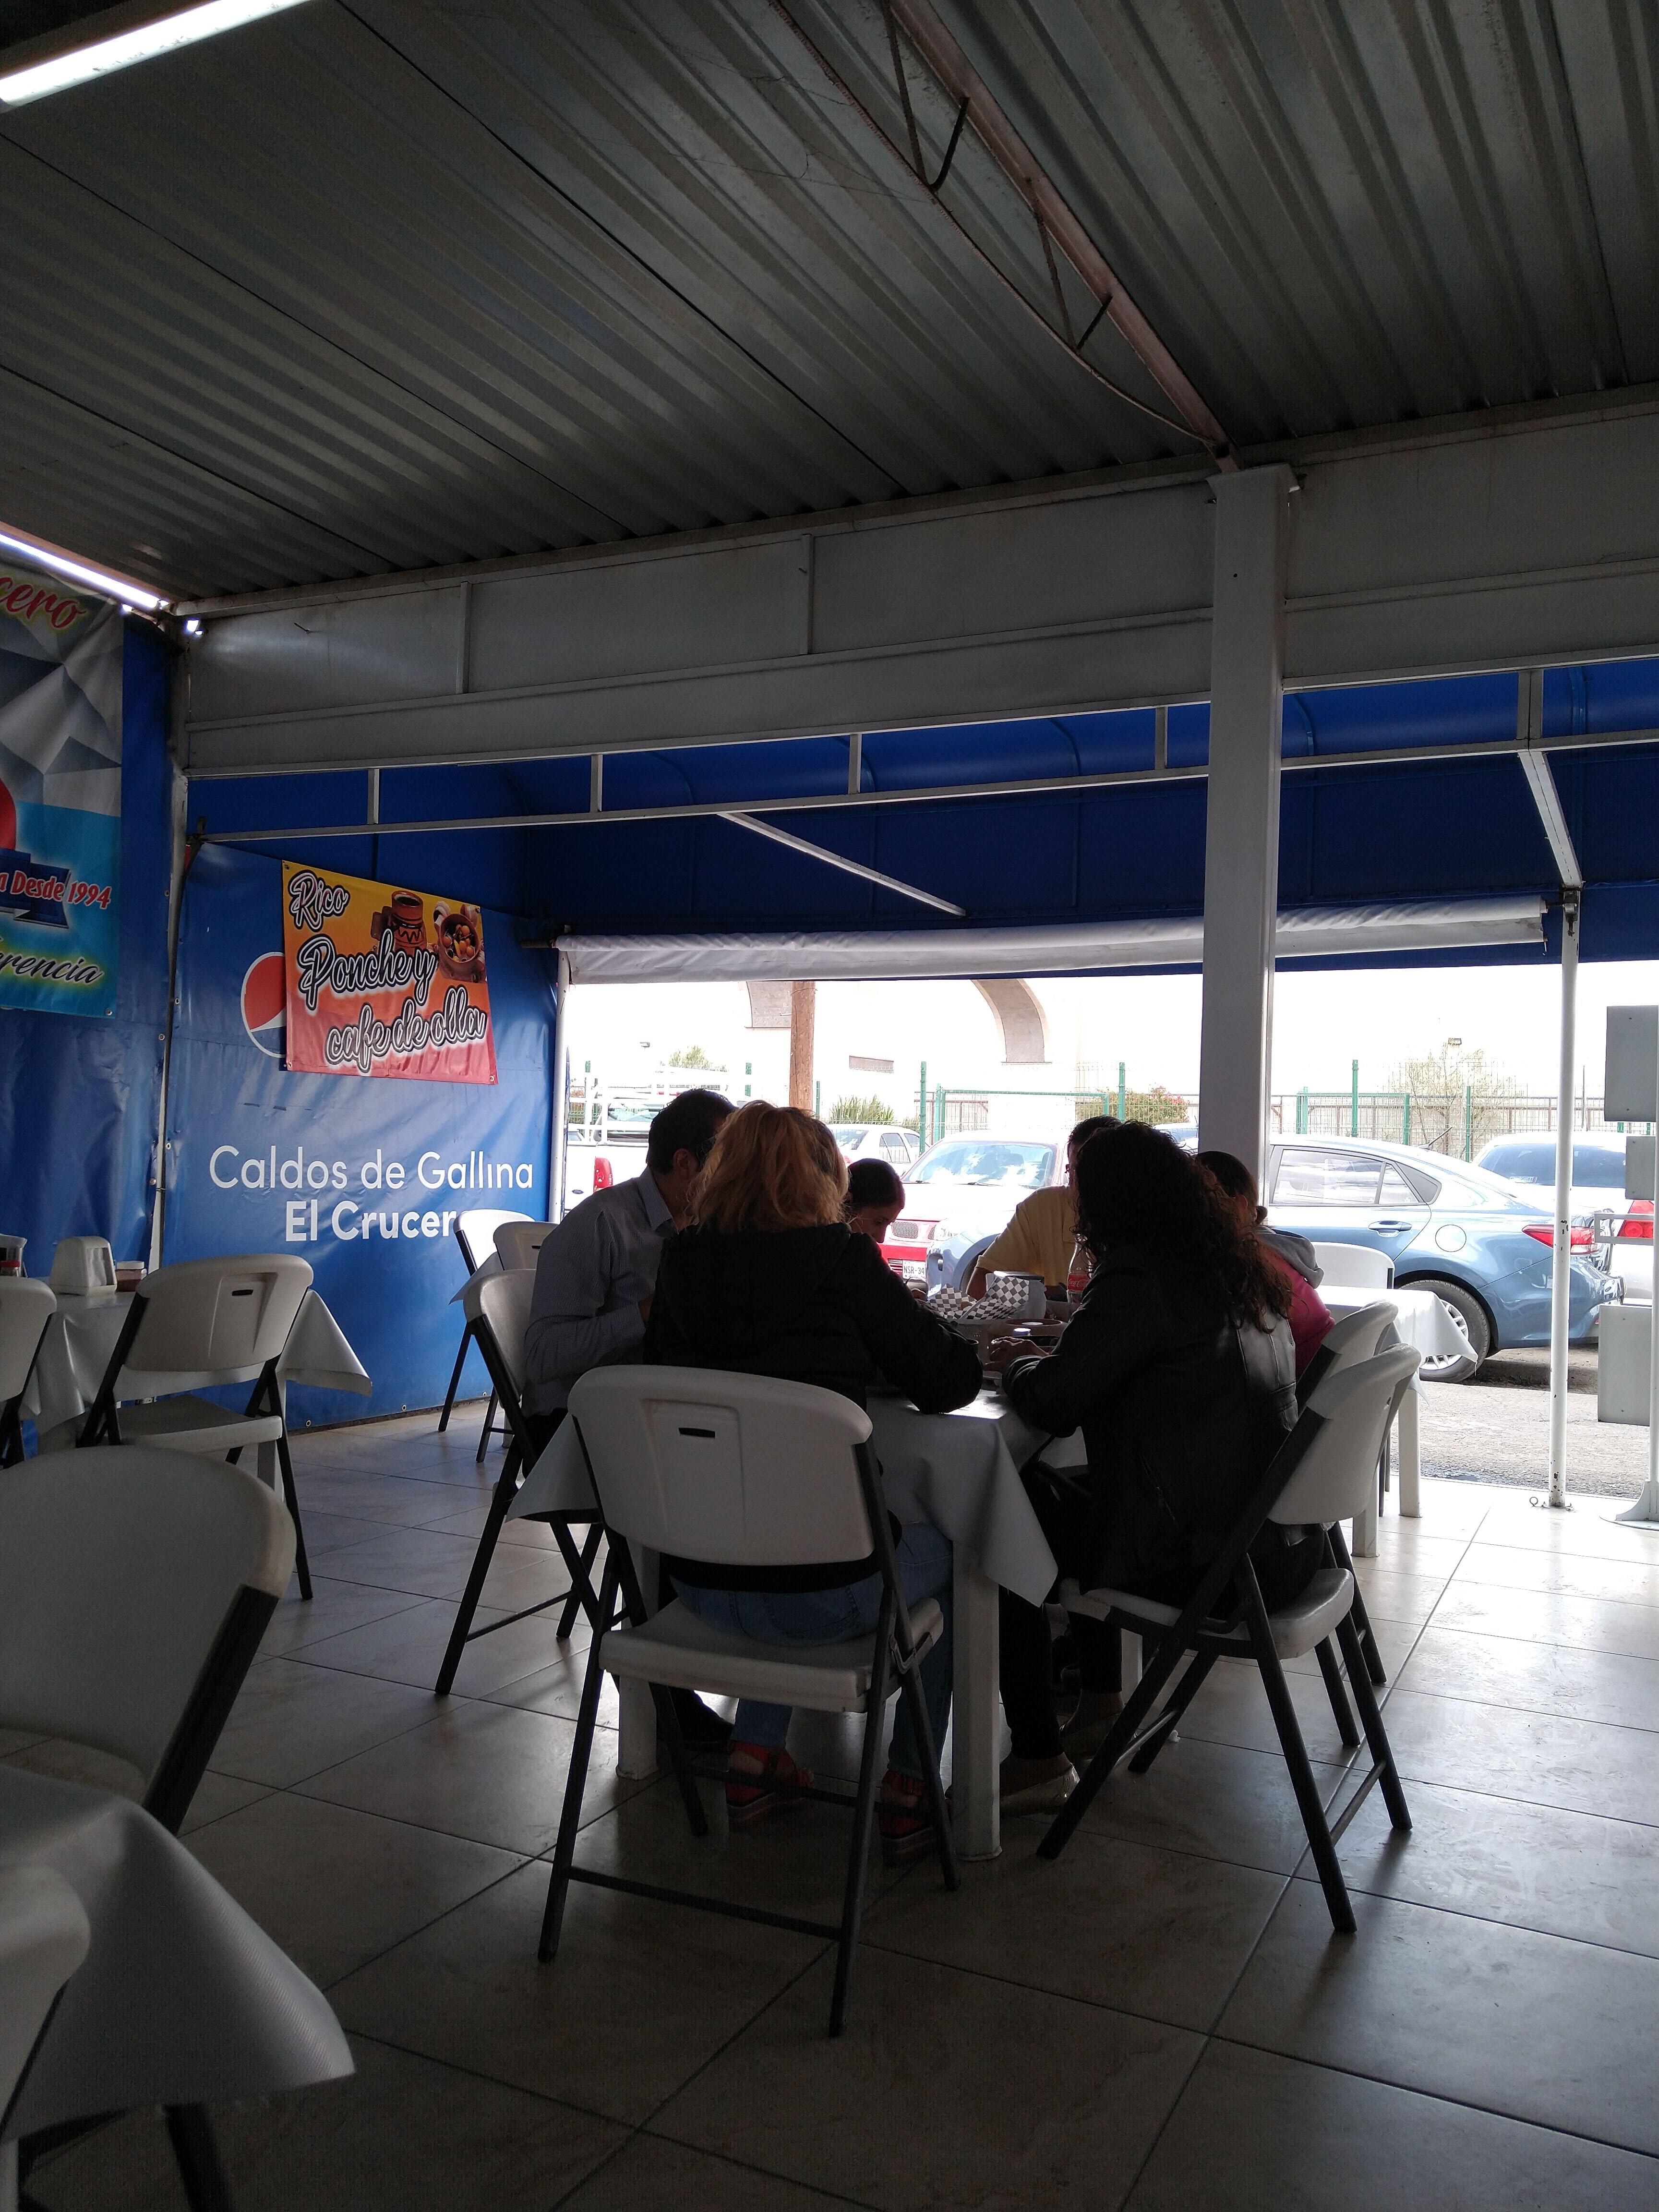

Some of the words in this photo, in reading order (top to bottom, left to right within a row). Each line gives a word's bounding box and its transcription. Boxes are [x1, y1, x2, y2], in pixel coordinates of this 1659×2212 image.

[11, 870, 64, 902] Desde
[67, 882, 111, 909] 1994
[290, 870, 350, 930] Rico
[298, 928, 414, 1010] Ponche
[325, 1002, 393, 1073] cafe
[391, 998, 430, 1052] de
[429, 985, 488, 1046] olla
[209, 1144, 348, 1190] Caldos
[361, 1149, 405, 1190] de
[286, 1199, 318, 1242] El
[331, 1201, 468, 1240] Crucer
